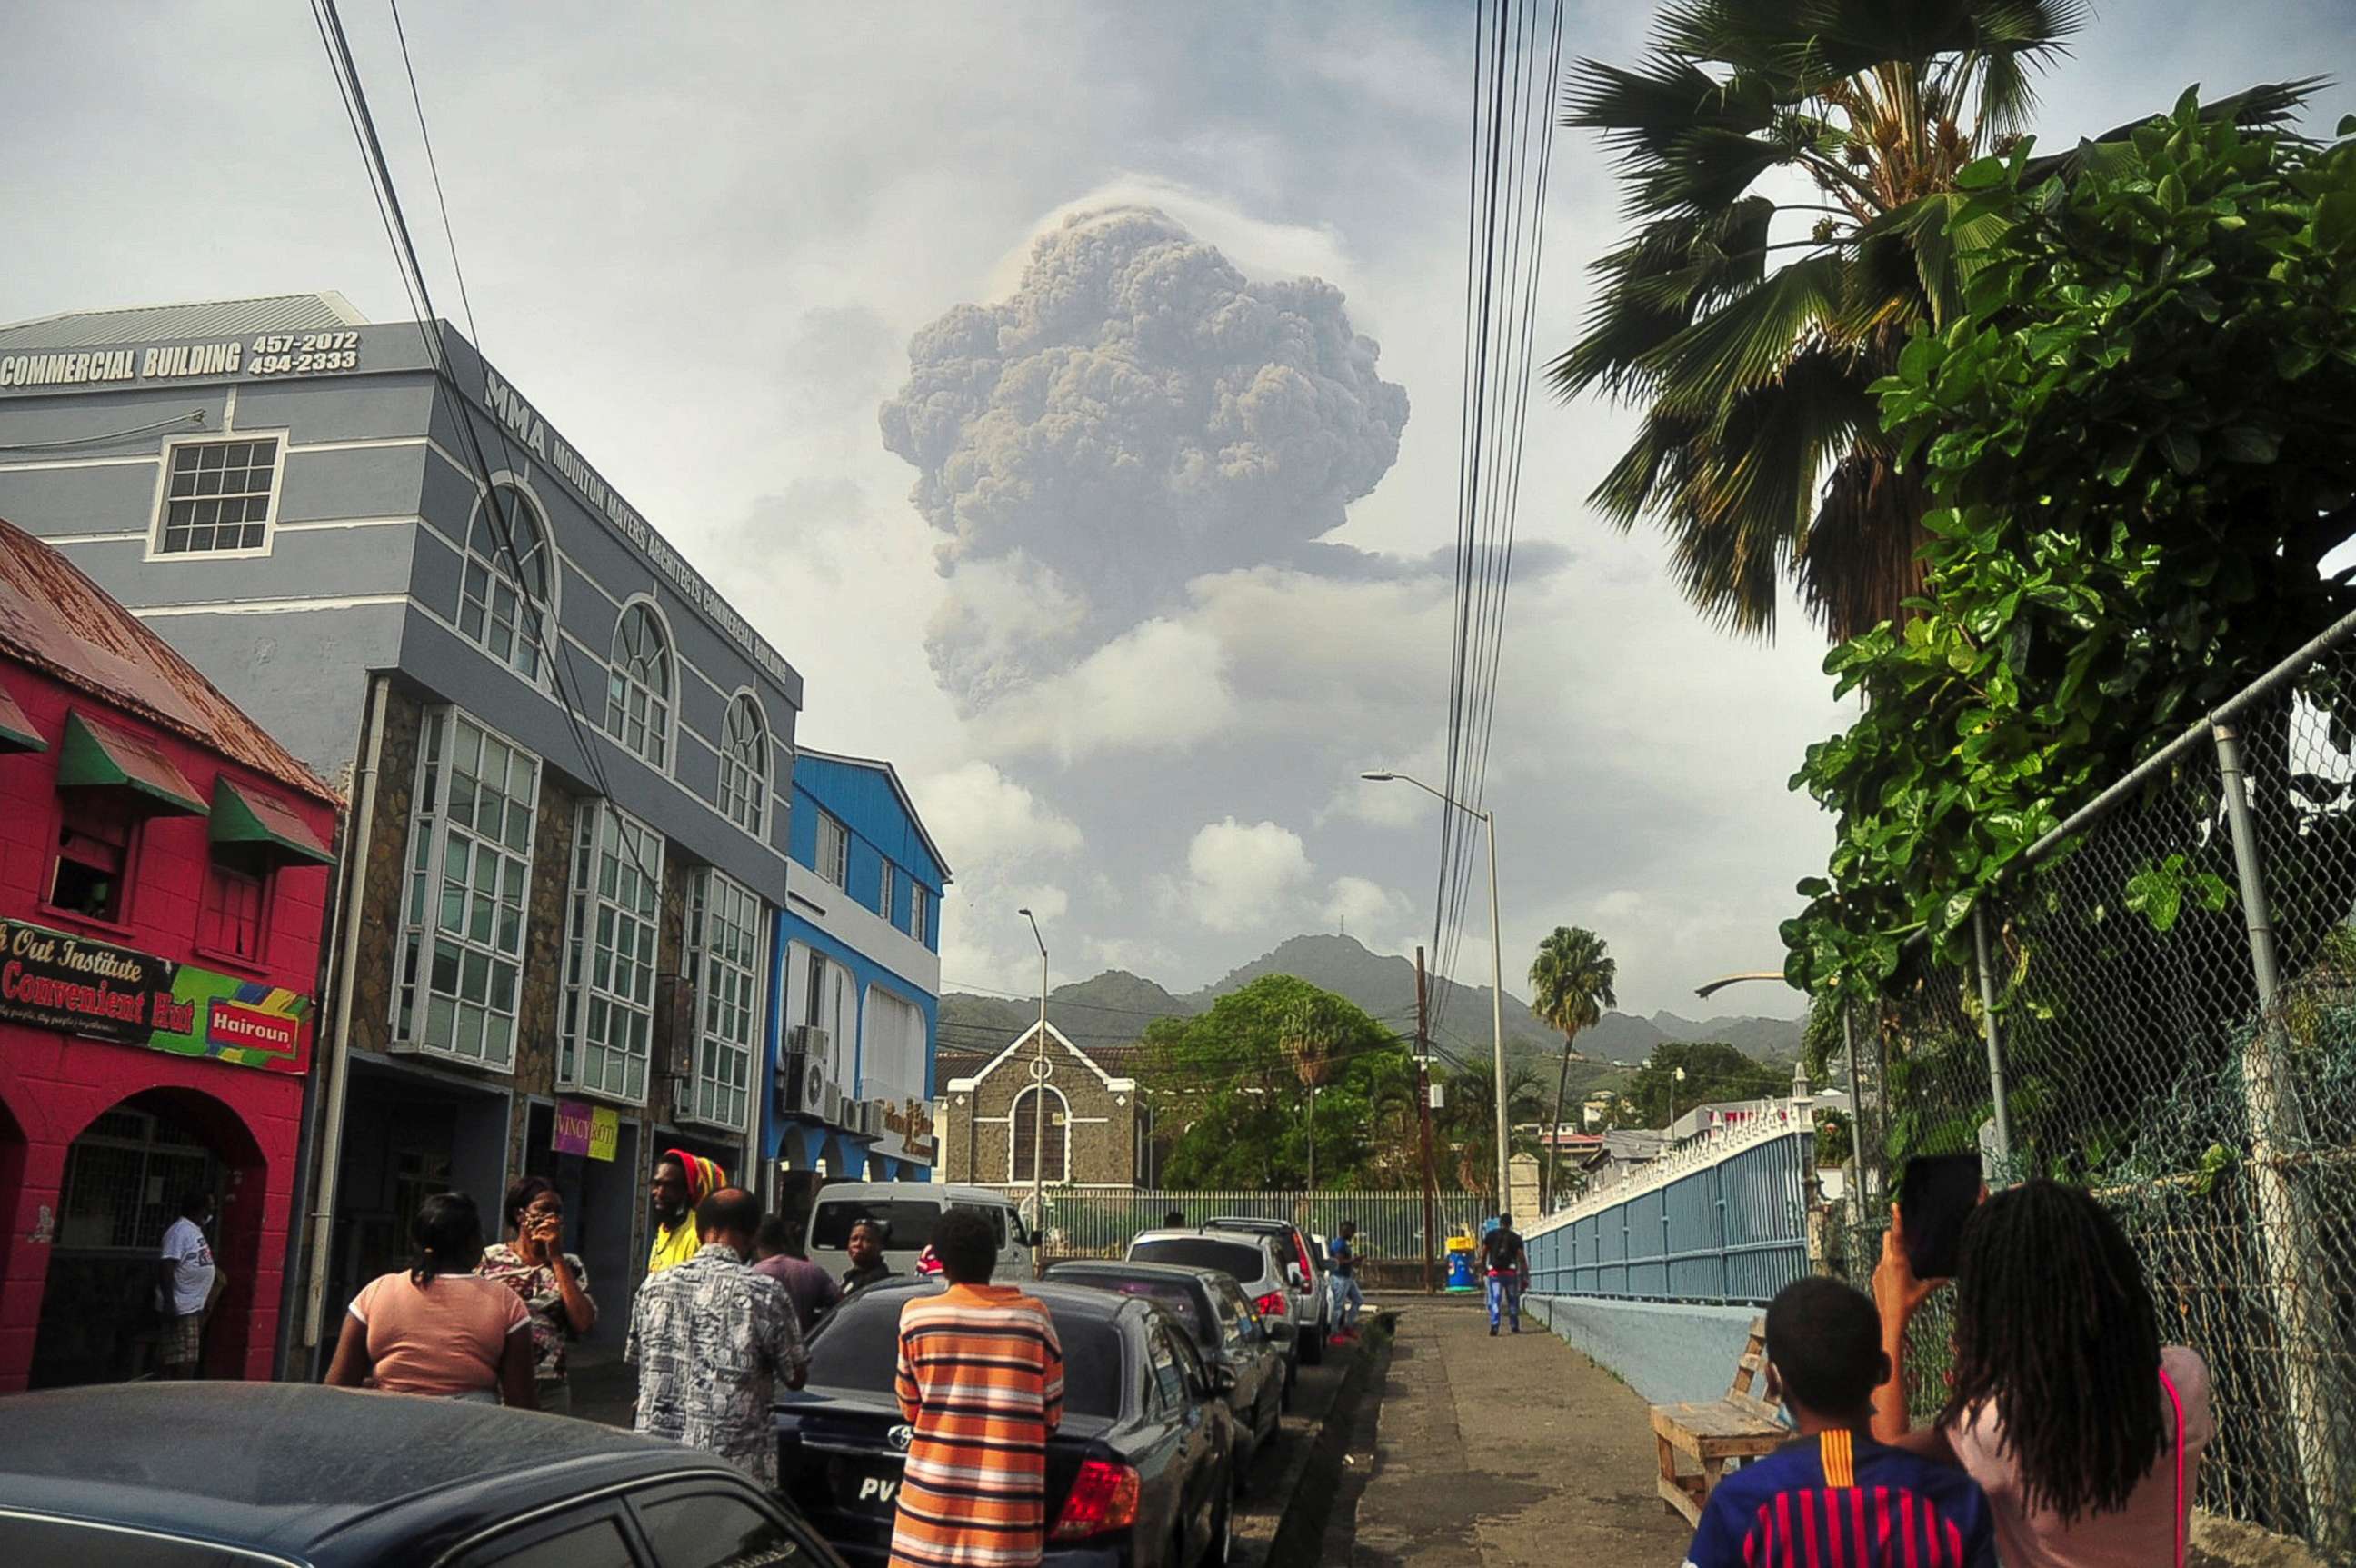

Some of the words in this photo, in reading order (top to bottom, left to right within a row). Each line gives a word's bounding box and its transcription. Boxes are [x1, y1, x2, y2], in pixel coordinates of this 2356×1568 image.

[253, 331, 358, 354] 457-2072
[0, 350, 135, 386] COMMERCIAL
[142, 342, 242, 378] BUILDING
[248, 351, 357, 375] 494-2333
[484, 369, 547, 462] MMA
[553, 439, 604, 510] MOULTON
[606, 493, 646, 551] MAYERS
[647, 532, 702, 604] ARCHITECTS
[13, 928, 57, 963] Out
[58, 939, 143, 983] Institute
[2, 960, 145, 1024] Convenient
[152, 991, 195, 1034] Hut
[213, 1012, 289, 1044] Hairoun
[558, 1114, 591, 1140] VINCY
